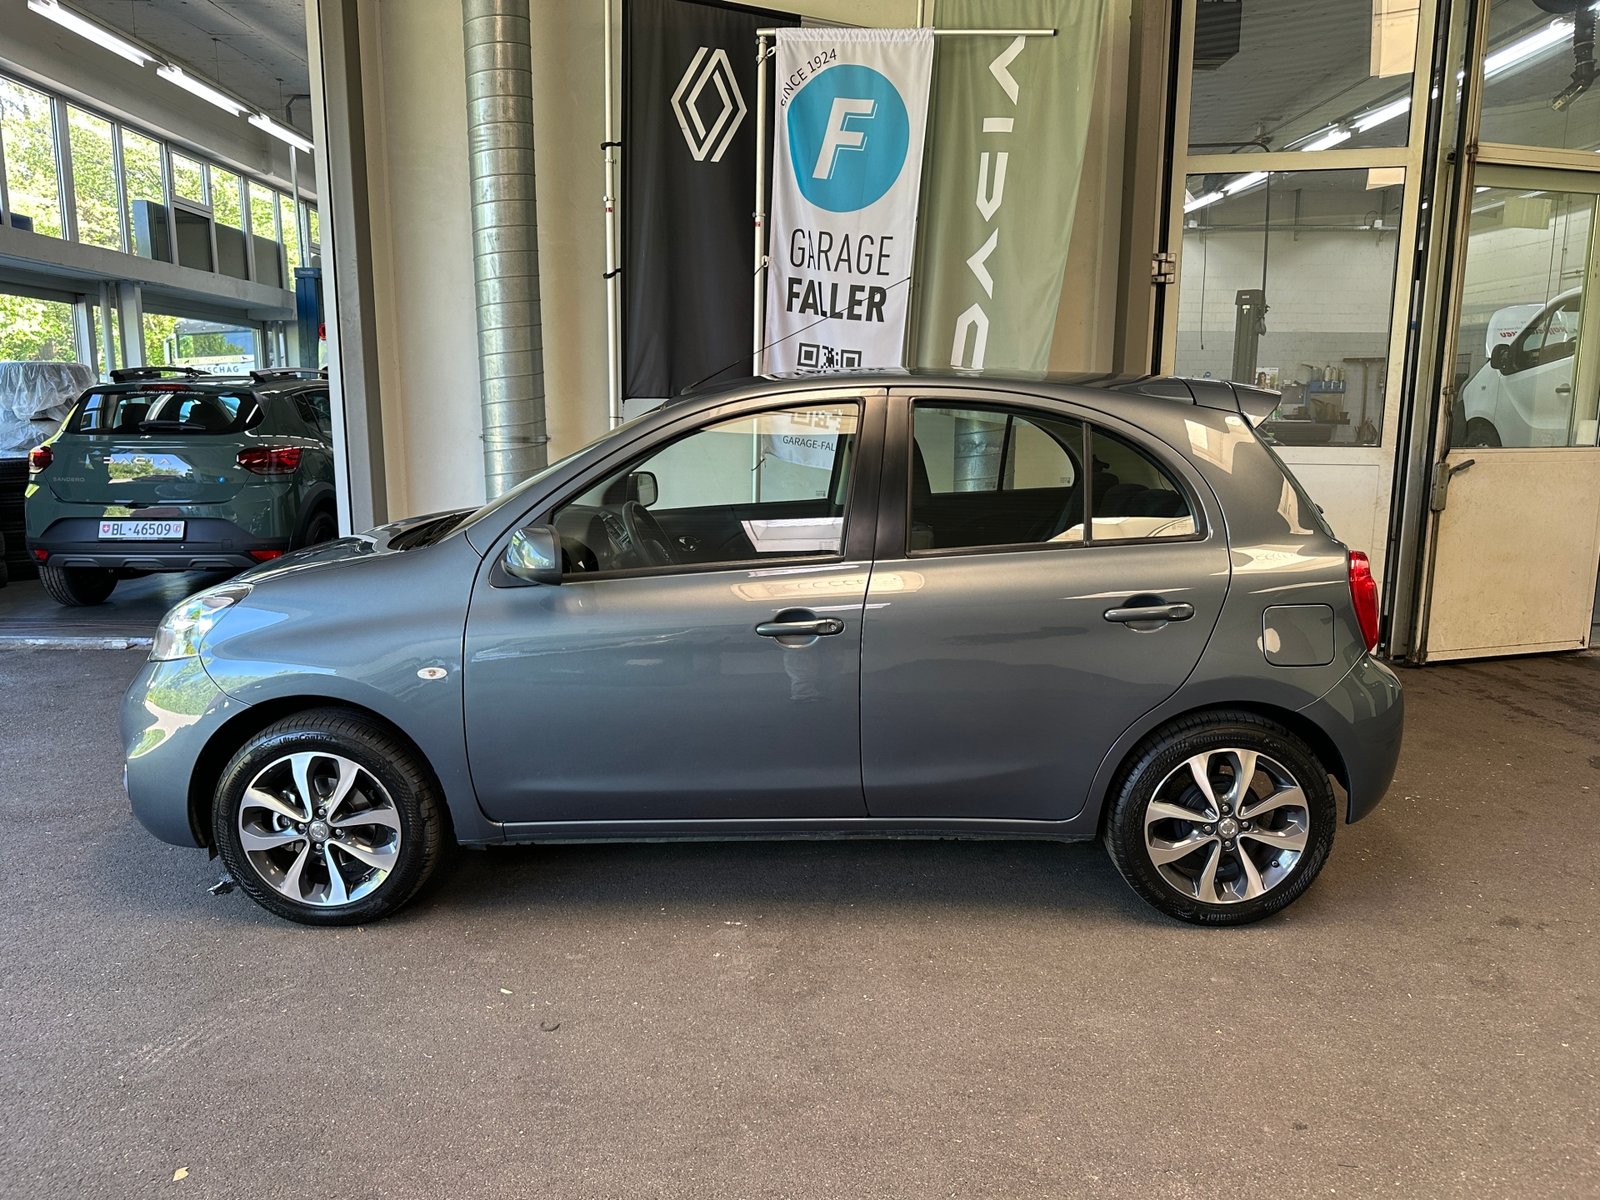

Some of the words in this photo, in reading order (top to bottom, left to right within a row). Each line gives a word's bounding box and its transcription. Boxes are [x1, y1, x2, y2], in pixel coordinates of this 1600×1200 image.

[781, 68, 808, 107] SINCE
[807, 48, 837, 73] 1924
[950, 36, 1026, 369] DACIA
[790, 228, 893, 276] GARAGE
[786, 277, 887, 322] FALLER
[103, 456, 172, 466] DACIA
